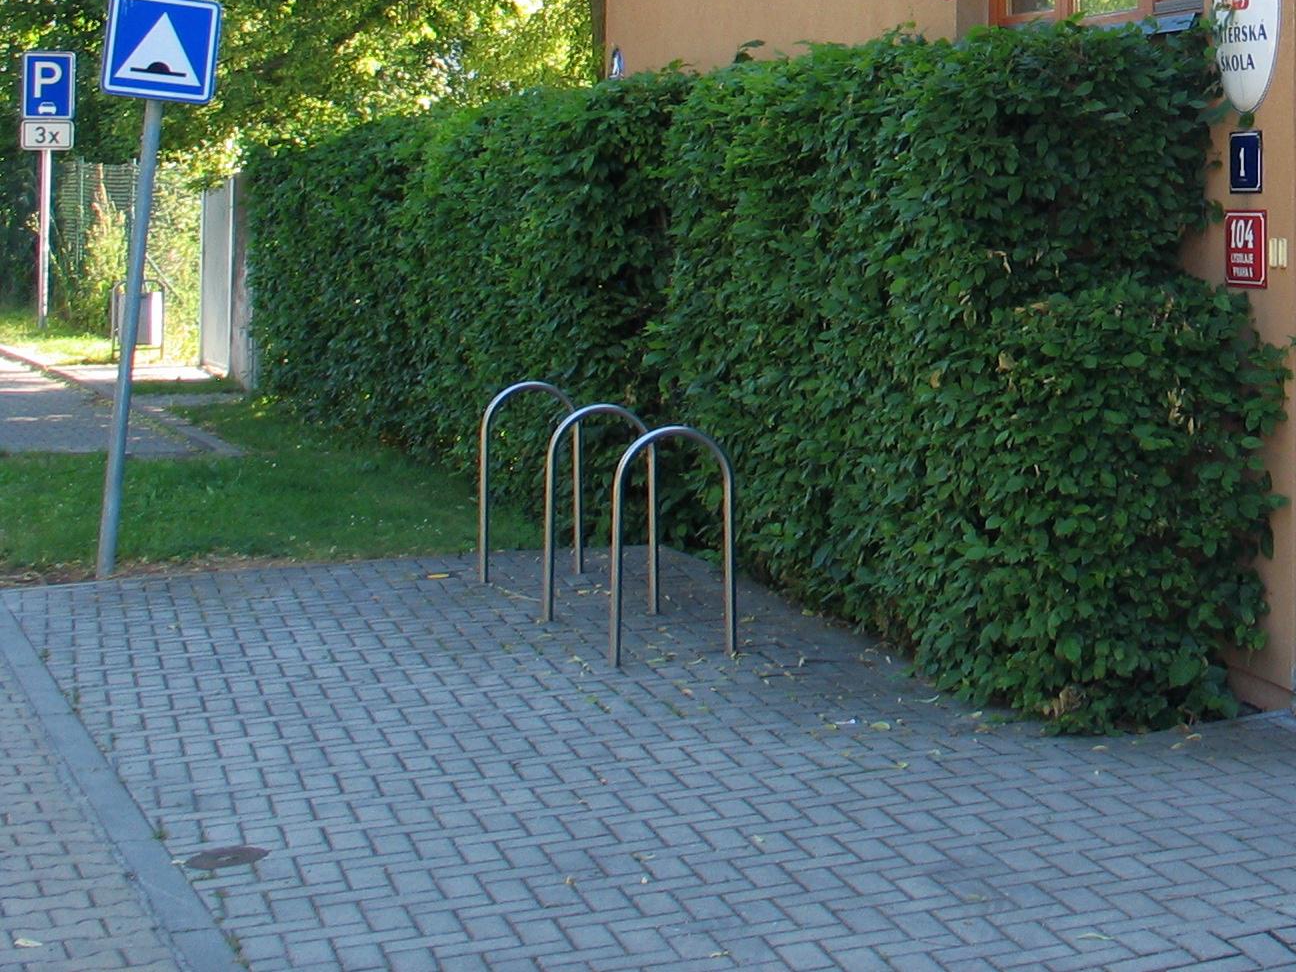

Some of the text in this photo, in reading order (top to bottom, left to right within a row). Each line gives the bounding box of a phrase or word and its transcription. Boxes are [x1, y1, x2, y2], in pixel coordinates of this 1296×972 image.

[1220, 51, 1255, 71] ŠKOLA
[33, 61, 62, 99] P
[34, 126, 60, 144] 3x
[1239, 147, 1246, 177] 1
[1231, 219, 1254, 248] 104
